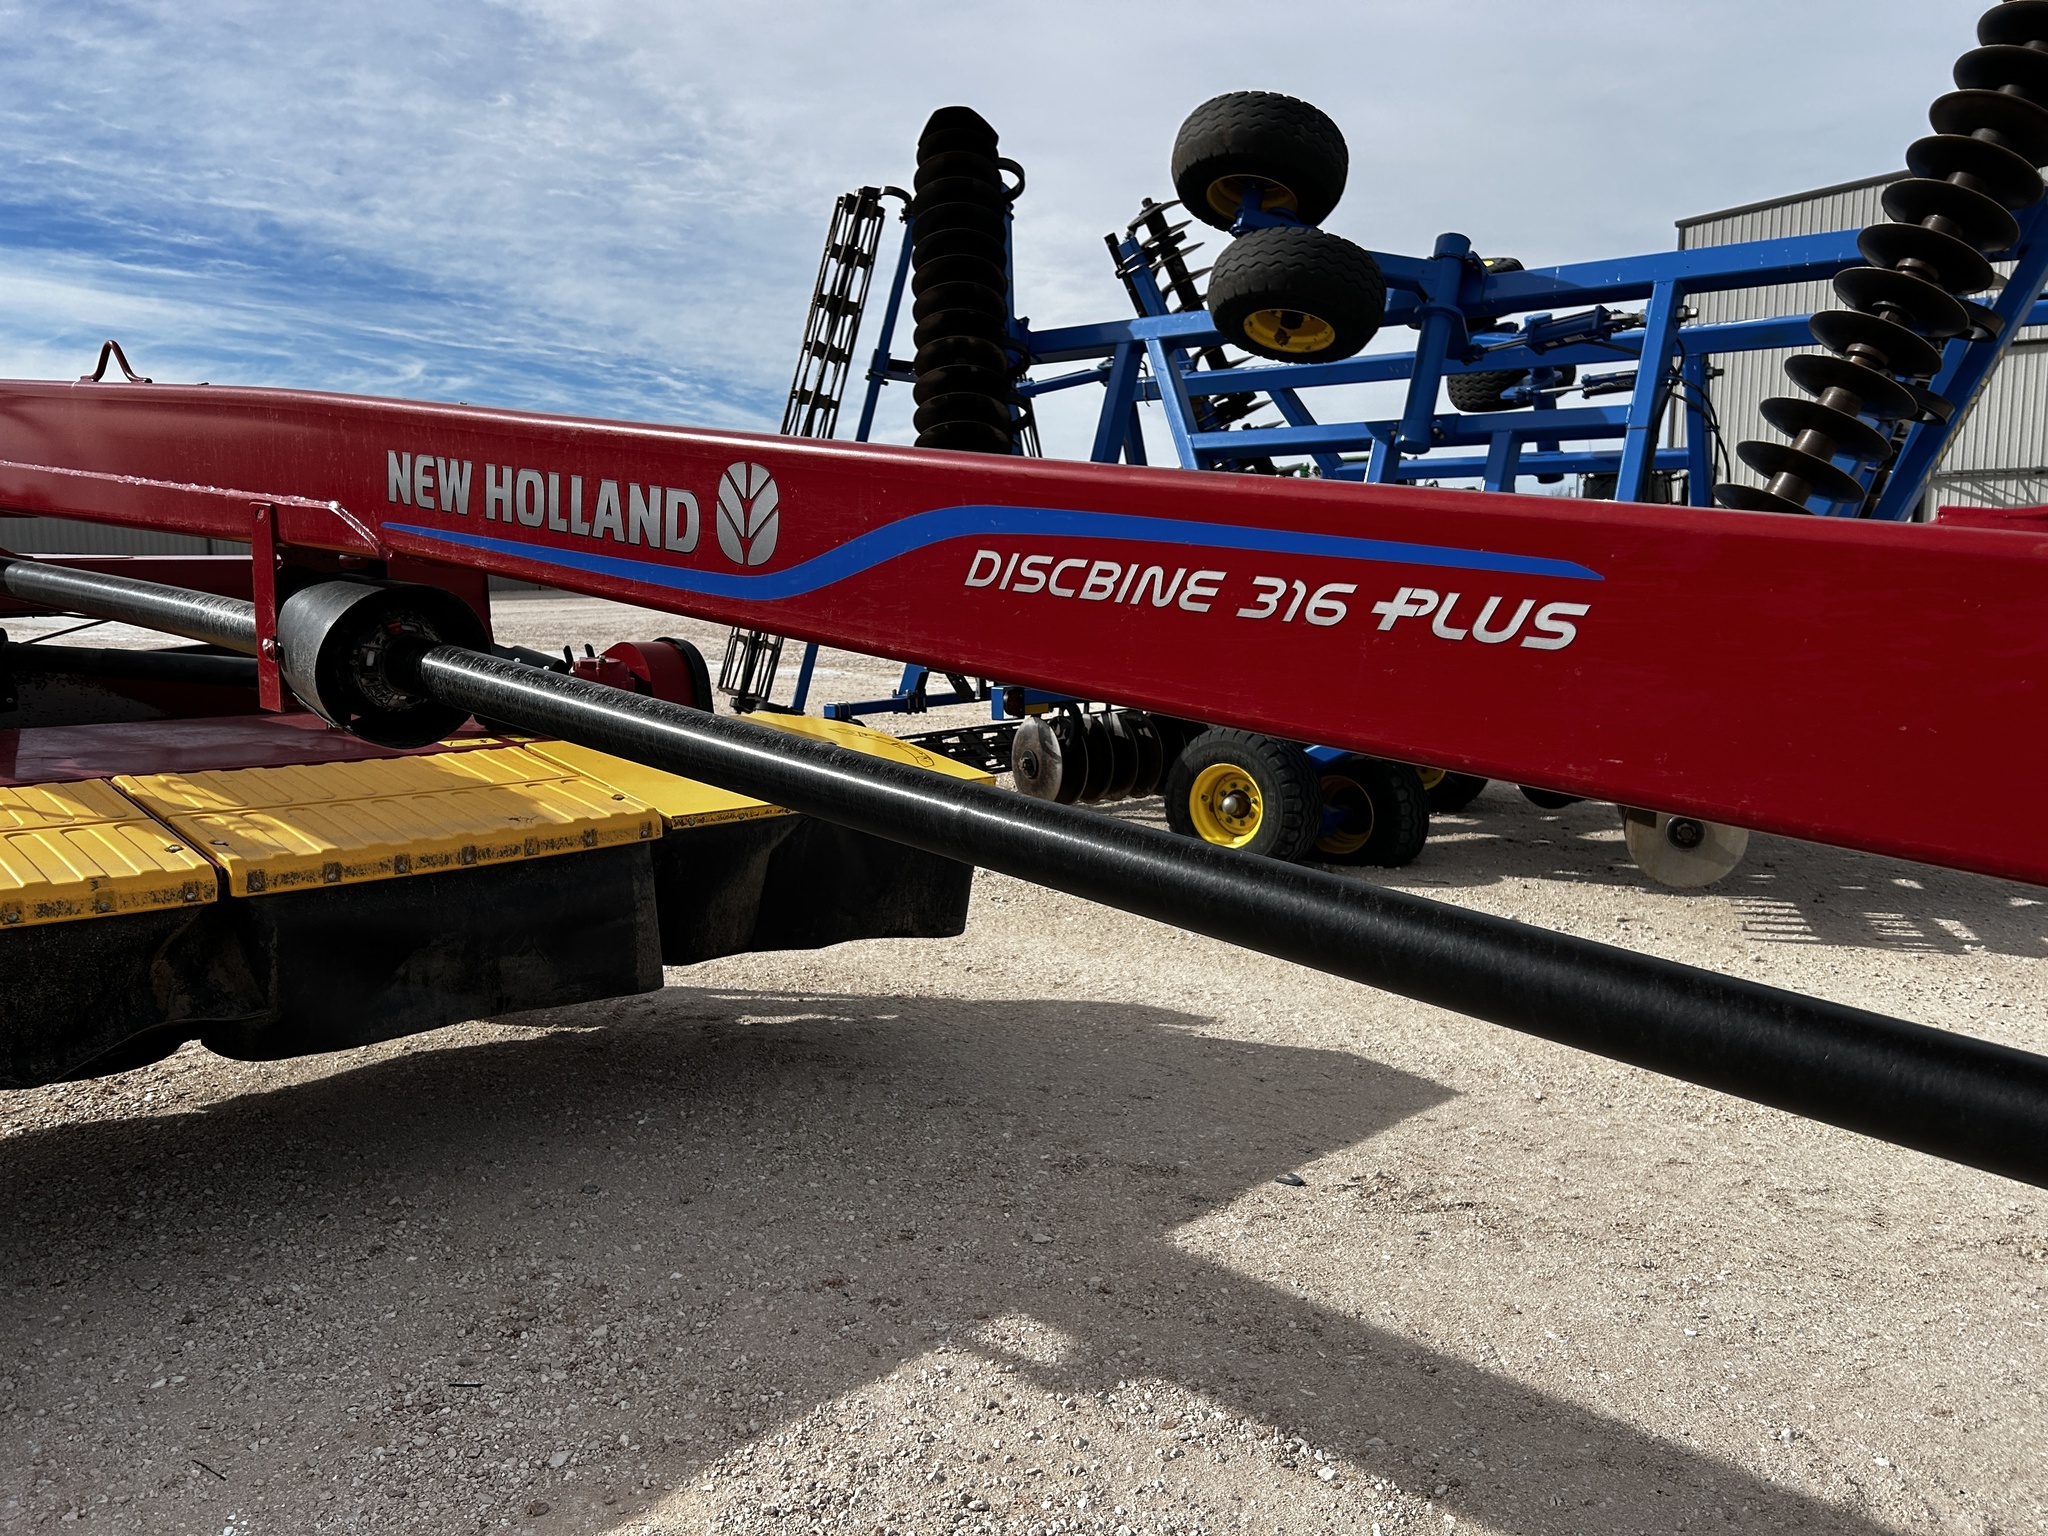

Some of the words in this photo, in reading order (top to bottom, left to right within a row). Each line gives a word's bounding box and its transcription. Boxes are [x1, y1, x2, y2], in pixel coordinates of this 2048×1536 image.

[387, 449, 473, 515] NEW
[485, 463, 701, 554] HOLLAND
[964, 549, 1227, 613] DISCBINE
[1236, 575, 1358, 627] 316
[1371, 586, 1592, 651] PLUS
